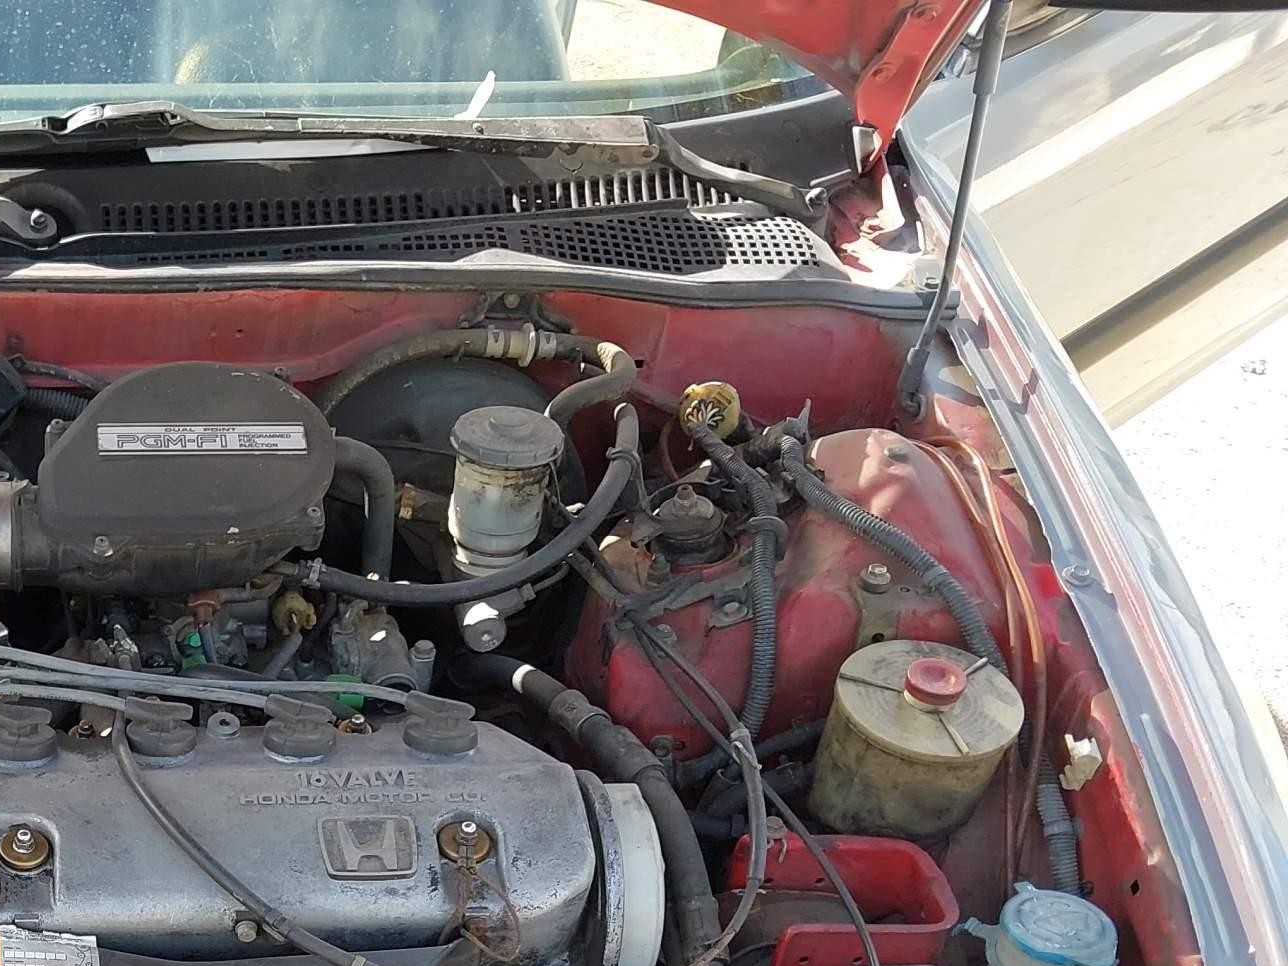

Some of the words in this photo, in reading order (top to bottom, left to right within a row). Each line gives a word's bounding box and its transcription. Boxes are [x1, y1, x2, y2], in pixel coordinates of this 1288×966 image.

[116, 434, 228, 449] PGM-FI
[239, 791, 333, 807] HONDA
[340, 791, 435, 804] MOTOR
